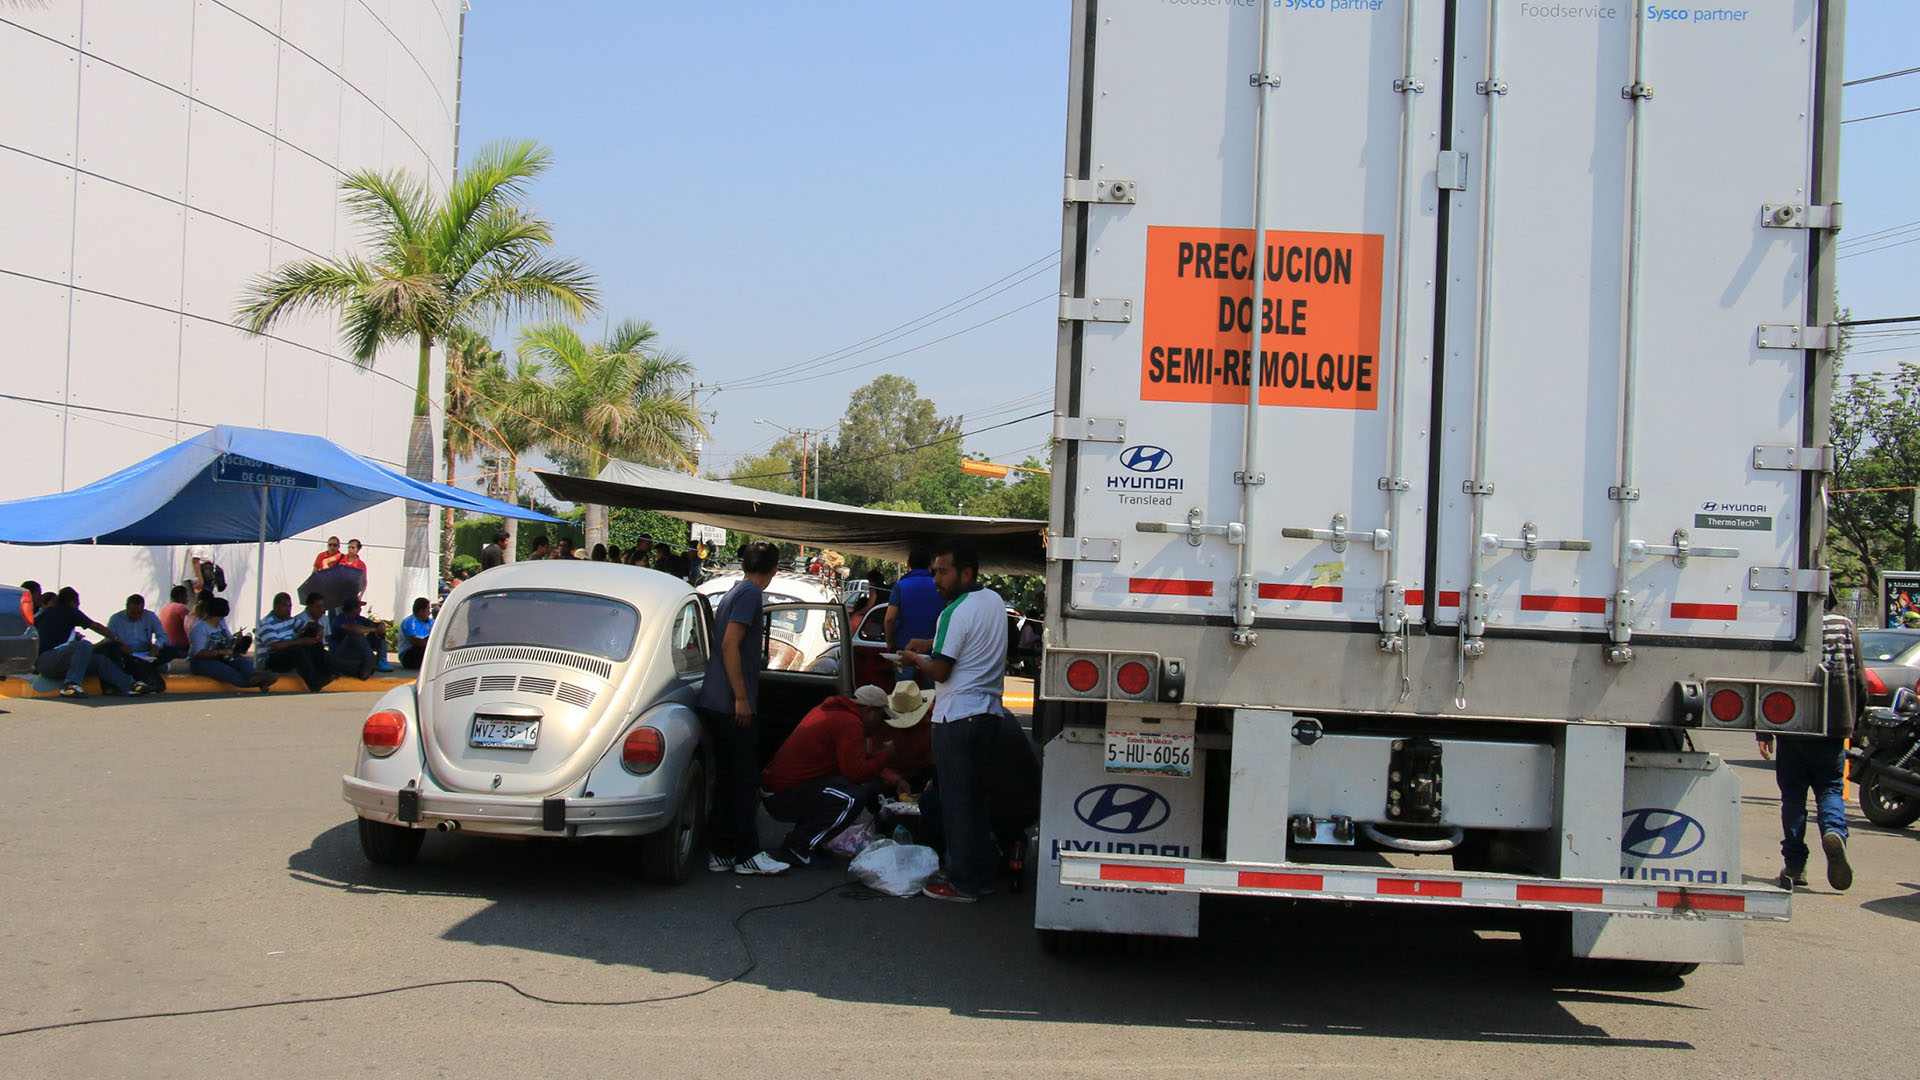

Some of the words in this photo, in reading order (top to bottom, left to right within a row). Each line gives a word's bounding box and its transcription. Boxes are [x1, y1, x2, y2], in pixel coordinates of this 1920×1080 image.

[1331, 0, 1383, 12] partner
[1521, 3, 1616, 19] Foodservice
[1647, 5, 1689, 22] Sysco
[1693, 8, 1748, 24] partner
[1218, 295, 1307, 335] DOBLE
[1149, 345, 1373, 392] SEMI-REMOLQUE
[256, 473, 296, 485] CLENTES
[1107, 476, 1184, 490] HYUNDAI
[1119, 494, 1172, 506] Translead
[1721, 504, 1766, 512] HYUNDAI
[474, 724, 537, 740] MVZ-35-16
[1108, 743, 1190, 765] 5-HU-6056
